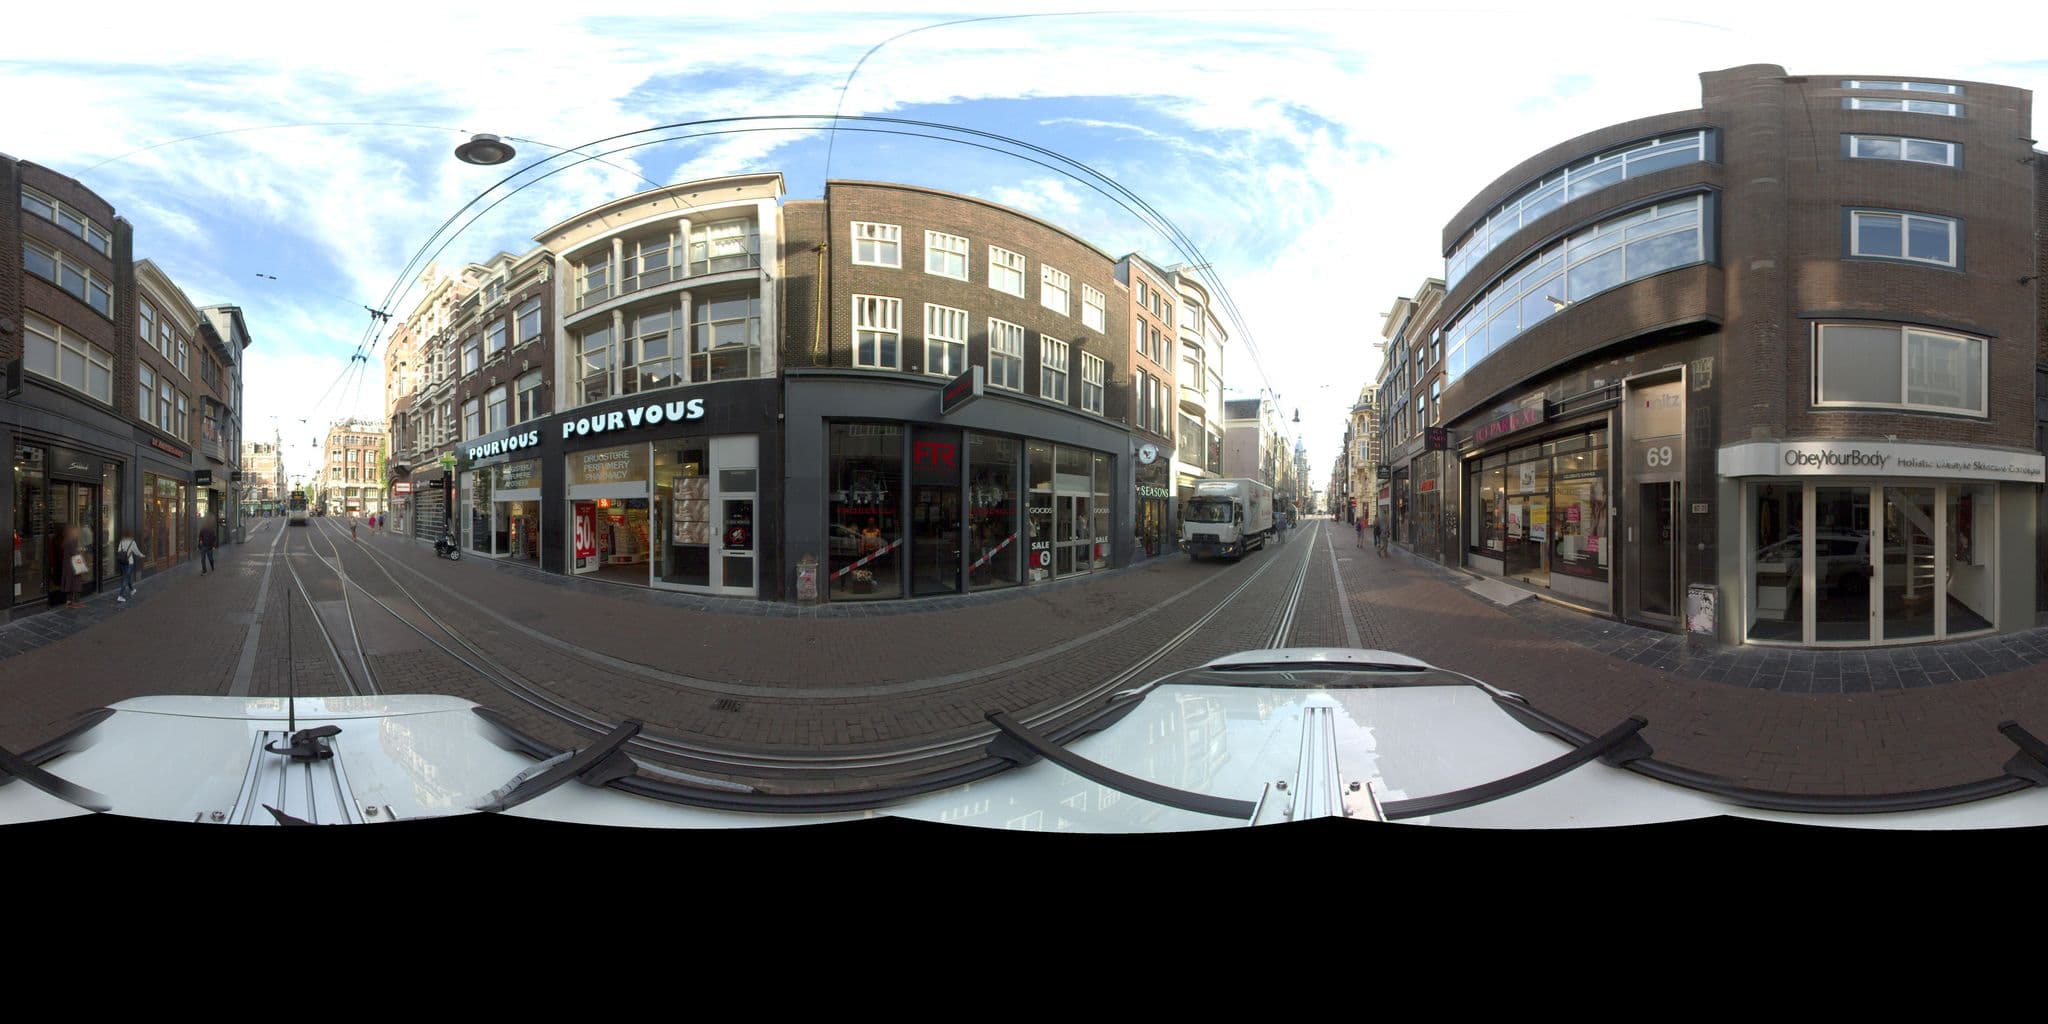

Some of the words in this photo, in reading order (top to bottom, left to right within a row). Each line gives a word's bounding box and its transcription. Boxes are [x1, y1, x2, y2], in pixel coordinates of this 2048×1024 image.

[583, 449, 630, 463] DRUGSTORE
[1646, 446, 1673, 467] 69
[583, 460, 630, 473] PERFUMERY
[1140, 485, 1169, 498] SEASONS
[1031, 541, 1050, 551] SALE
[1095, 535, 1109, 544] SALE
